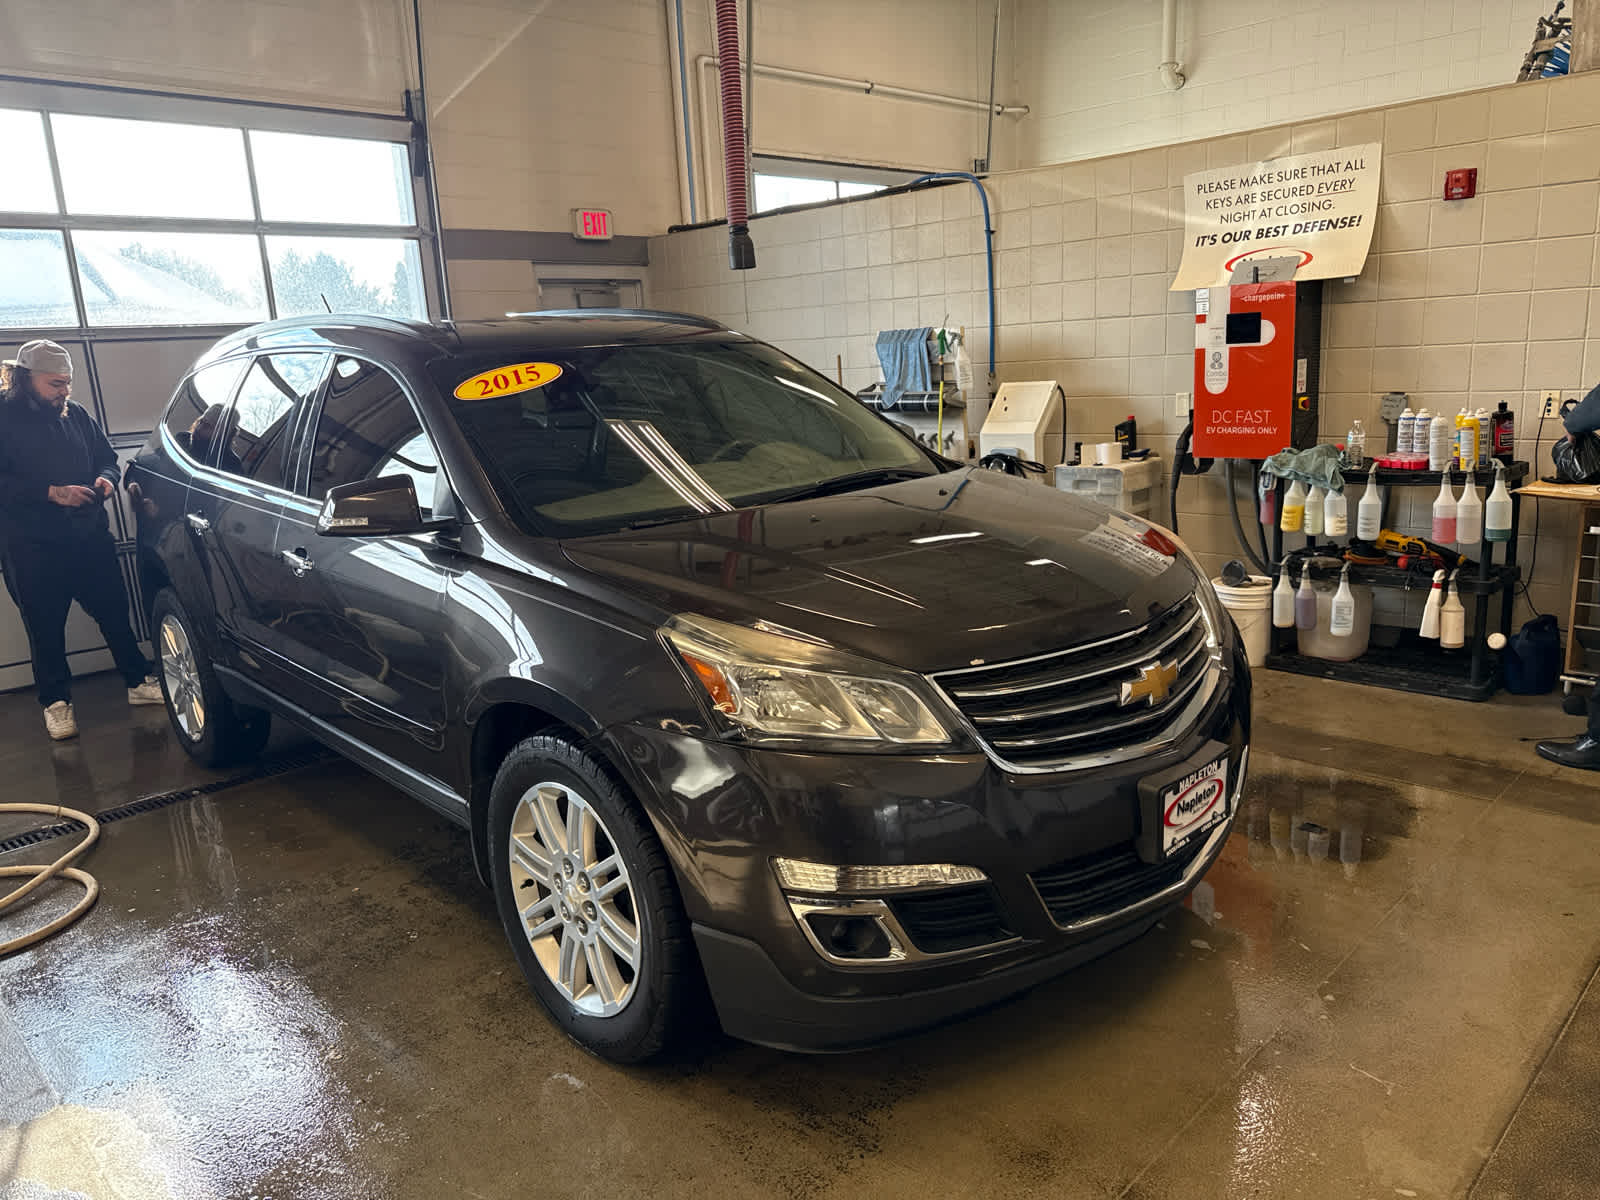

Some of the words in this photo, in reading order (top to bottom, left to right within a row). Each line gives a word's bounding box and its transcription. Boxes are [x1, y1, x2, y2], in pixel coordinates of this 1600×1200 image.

[1197, 179, 1236, 195] PLEASE
[1239, 173, 1274, 189] MAKE
[1277, 167, 1308, 183] SURE
[1311, 162, 1342, 177] THAT
[1344, 158, 1366, 172] ALL
[1205, 195, 1232, 211] KEYS
[1235, 192, 1257, 206] ARE
[1260, 184, 1315, 203] SECURED
[1317, 177, 1356, 194] EVERY
[583, 211, 607, 237] EXIT
[1220, 209, 1256, 225] NIGHT
[1259, 207, 1272, 219] AT
[1275, 199, 1336, 218] CLOSING.
[1195, 232, 1217, 248] IT'S
[1221, 228, 1251, 243] OUR
[1255, 224, 1289, 240] BEST
[1292, 214, 1363, 235] DEFENSE!
[475, 365, 541, 396] 2015
[1206, 426, 1216, 434] EV
[1216, 426, 1256, 435] CHARGING
[1257, 426, 1278, 435] ONLY
[1212, 410, 1233, 424] DC
[1236, 409, 1272, 424] FAST
[1179, 760, 1218, 793] NAPLETON
[1177, 784, 1216, 816] Napleton
